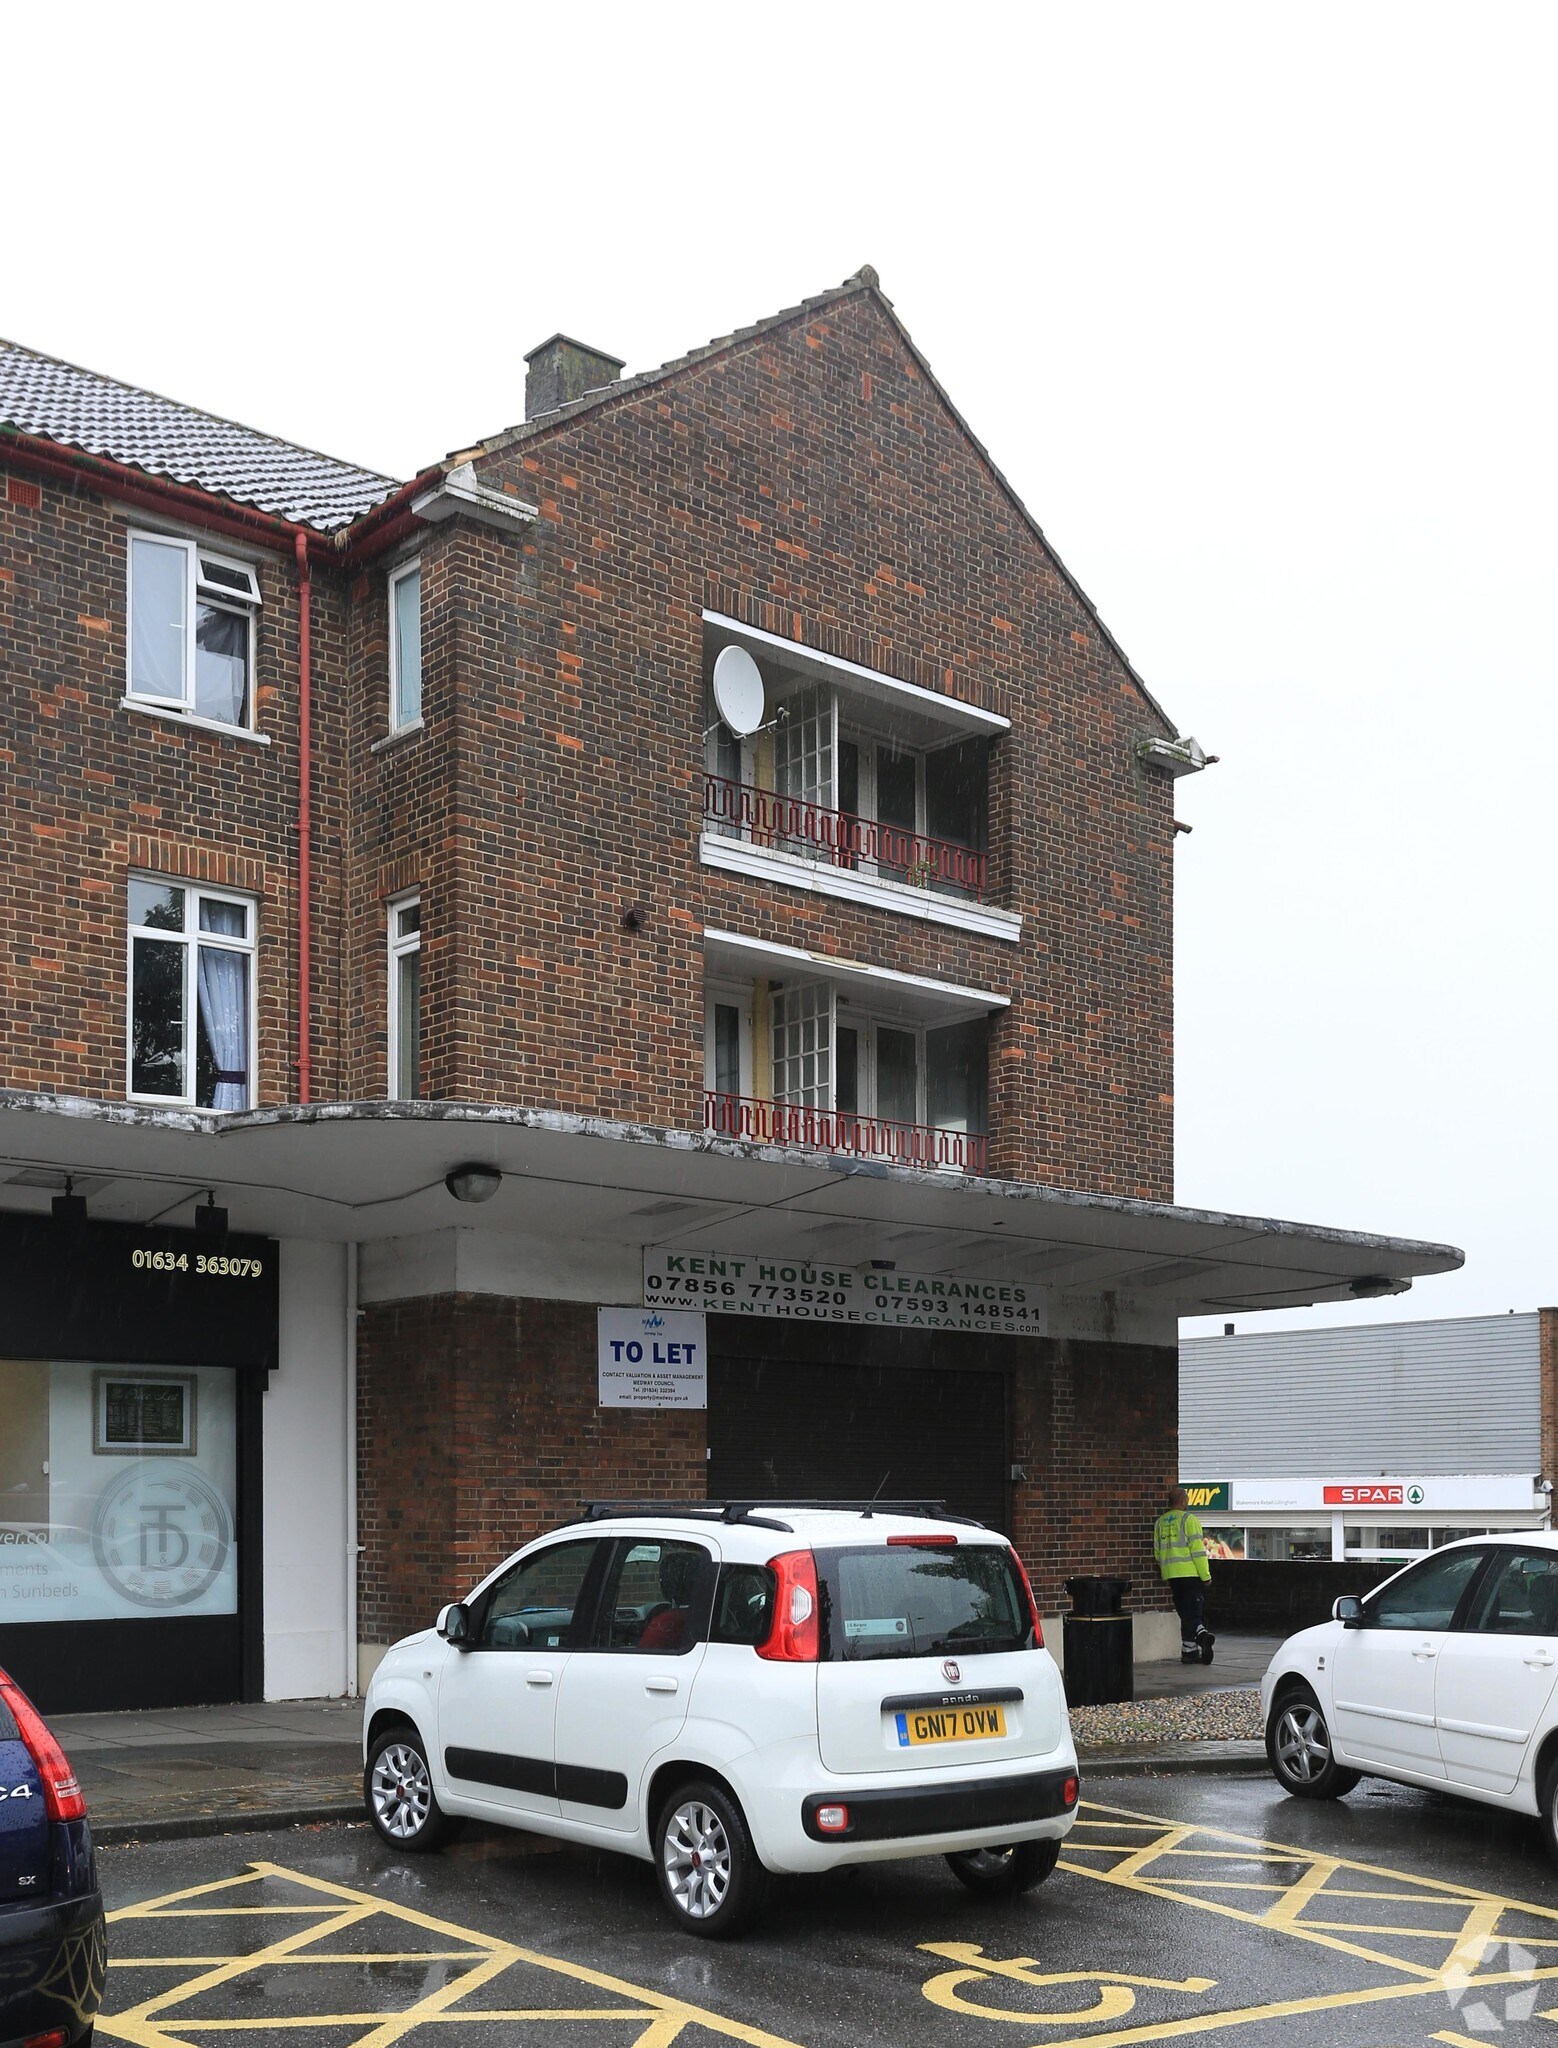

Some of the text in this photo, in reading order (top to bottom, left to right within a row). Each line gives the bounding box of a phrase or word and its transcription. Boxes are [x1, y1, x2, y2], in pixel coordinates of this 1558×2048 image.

[132, 1249, 262, 1278] 01634 363079
[667, 1255, 1026, 1303] KENT HOUSE CLEARANCES
[647, 1274, 1040, 1321] 07856 773520 07593 148541
[609, 1340, 697, 1365] TO LET
[1341, 1488, 1402, 1502] SPAR
[12, 1582, 79, 1599] Sunbeds
[942, 1694, 979, 1705] panda
[914, 1710, 999, 1739] GN17 OVW
[18, 1875, 36, 1885] SX
